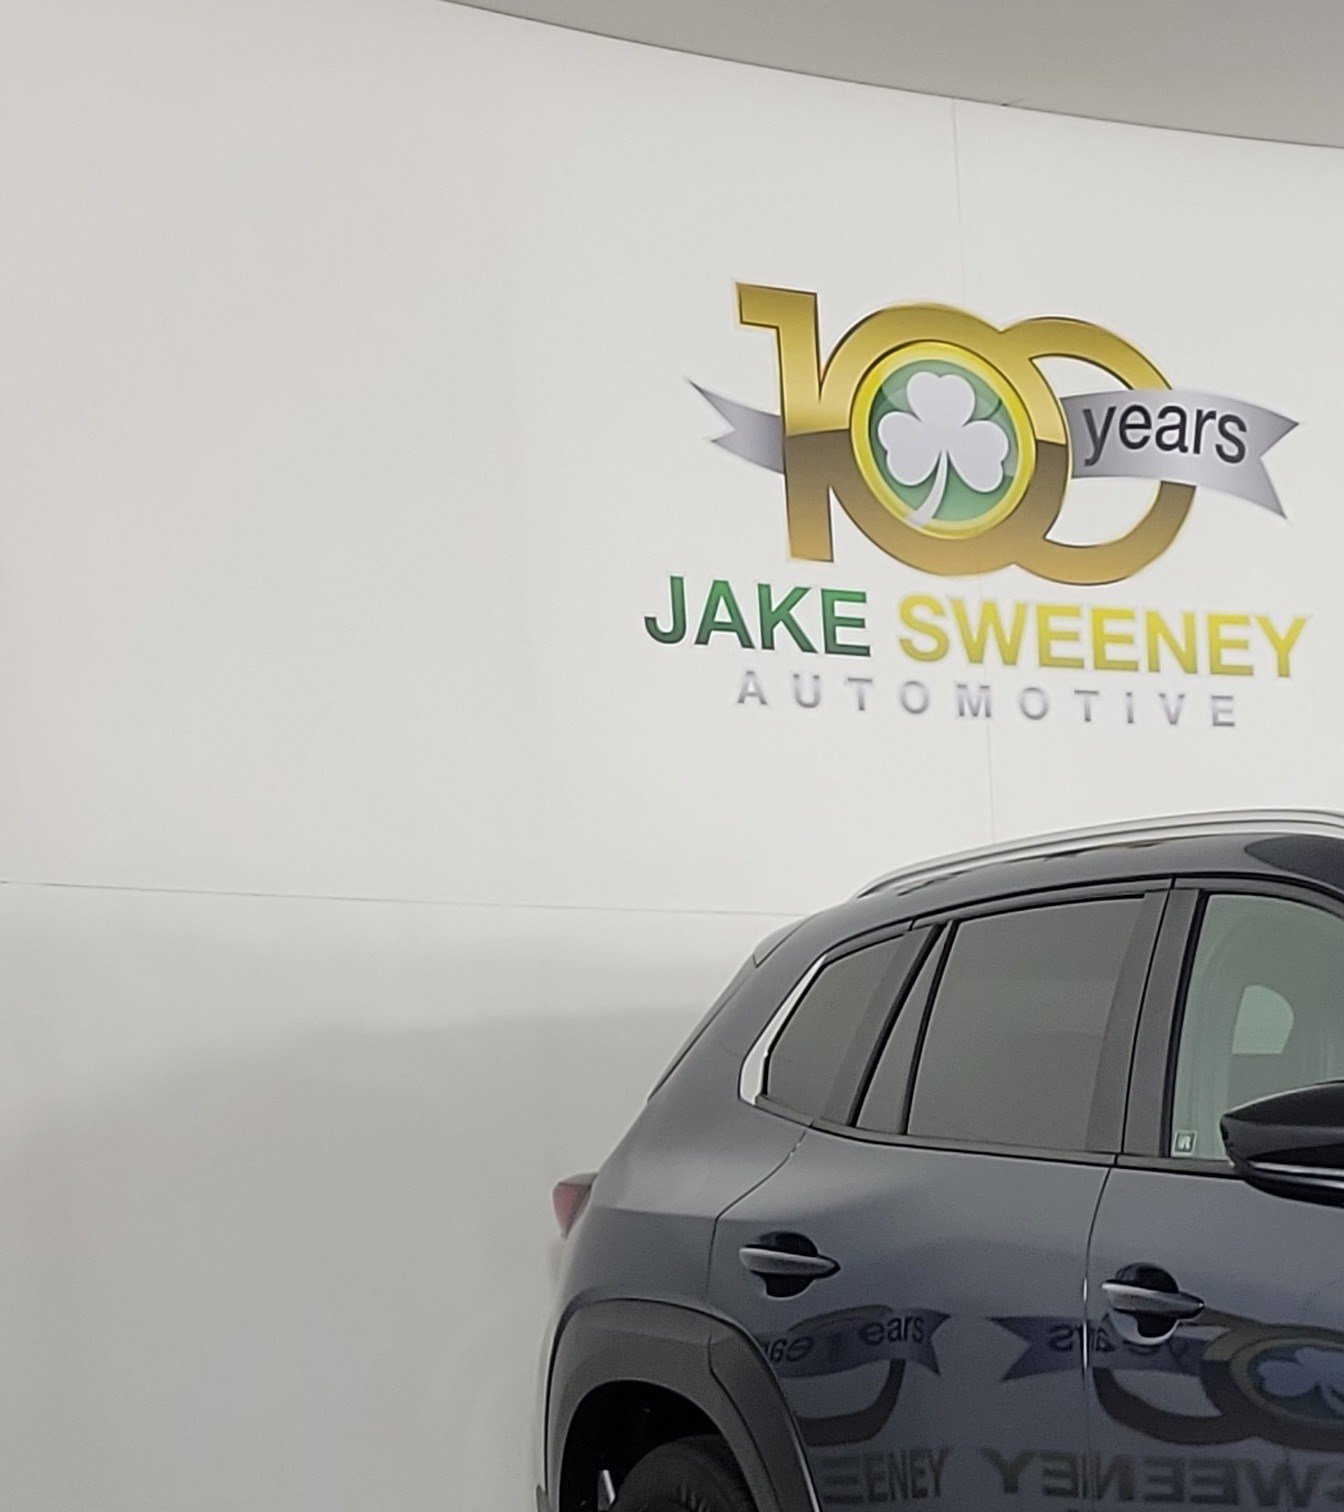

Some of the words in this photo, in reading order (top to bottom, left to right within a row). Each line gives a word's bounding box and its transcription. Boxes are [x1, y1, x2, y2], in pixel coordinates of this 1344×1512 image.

[735, 281, 1198, 587] 100
[1084, 403, 1247, 466] years
[643, 574, 872, 657] JAKE
[898, 595, 1311, 678] SWEENEY
[735, 670, 1237, 727] AUTOMOTIVE
